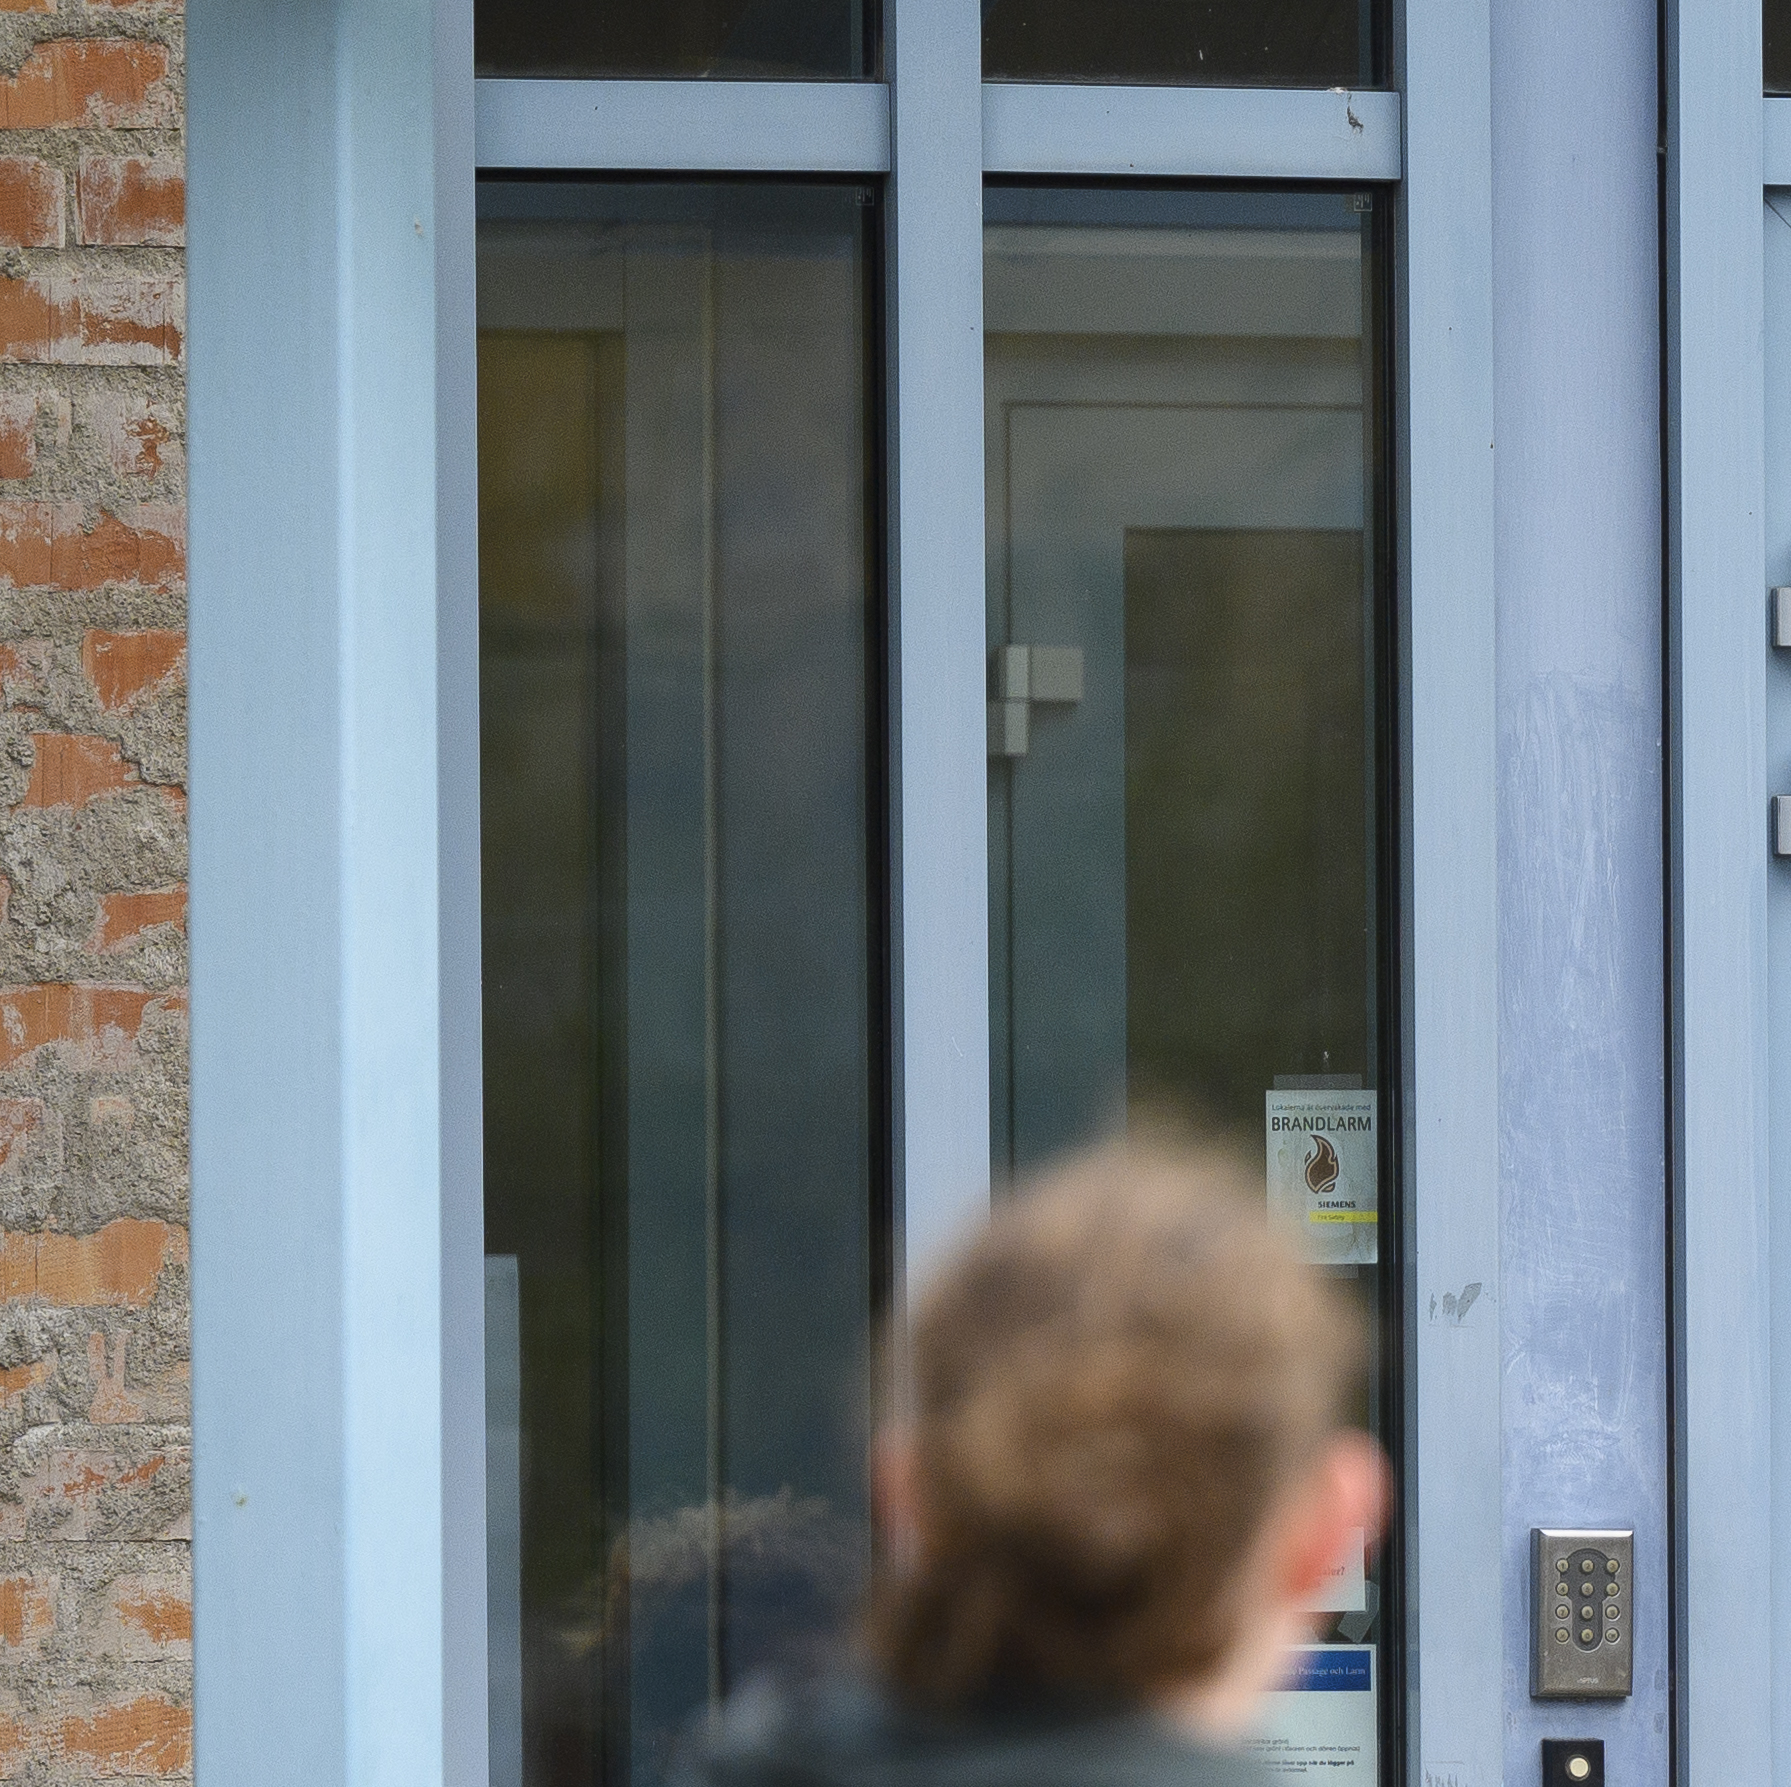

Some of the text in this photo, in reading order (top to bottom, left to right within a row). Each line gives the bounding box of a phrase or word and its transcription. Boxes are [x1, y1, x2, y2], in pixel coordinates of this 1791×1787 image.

[1271, 1116, 1372, 1132] BRANDLARM
[1317, 1200, 1356, 1209] SIEMENS
[1330, 1666, 1343, 1675] och
[1345, 1666, 1366, 1675] Larm
